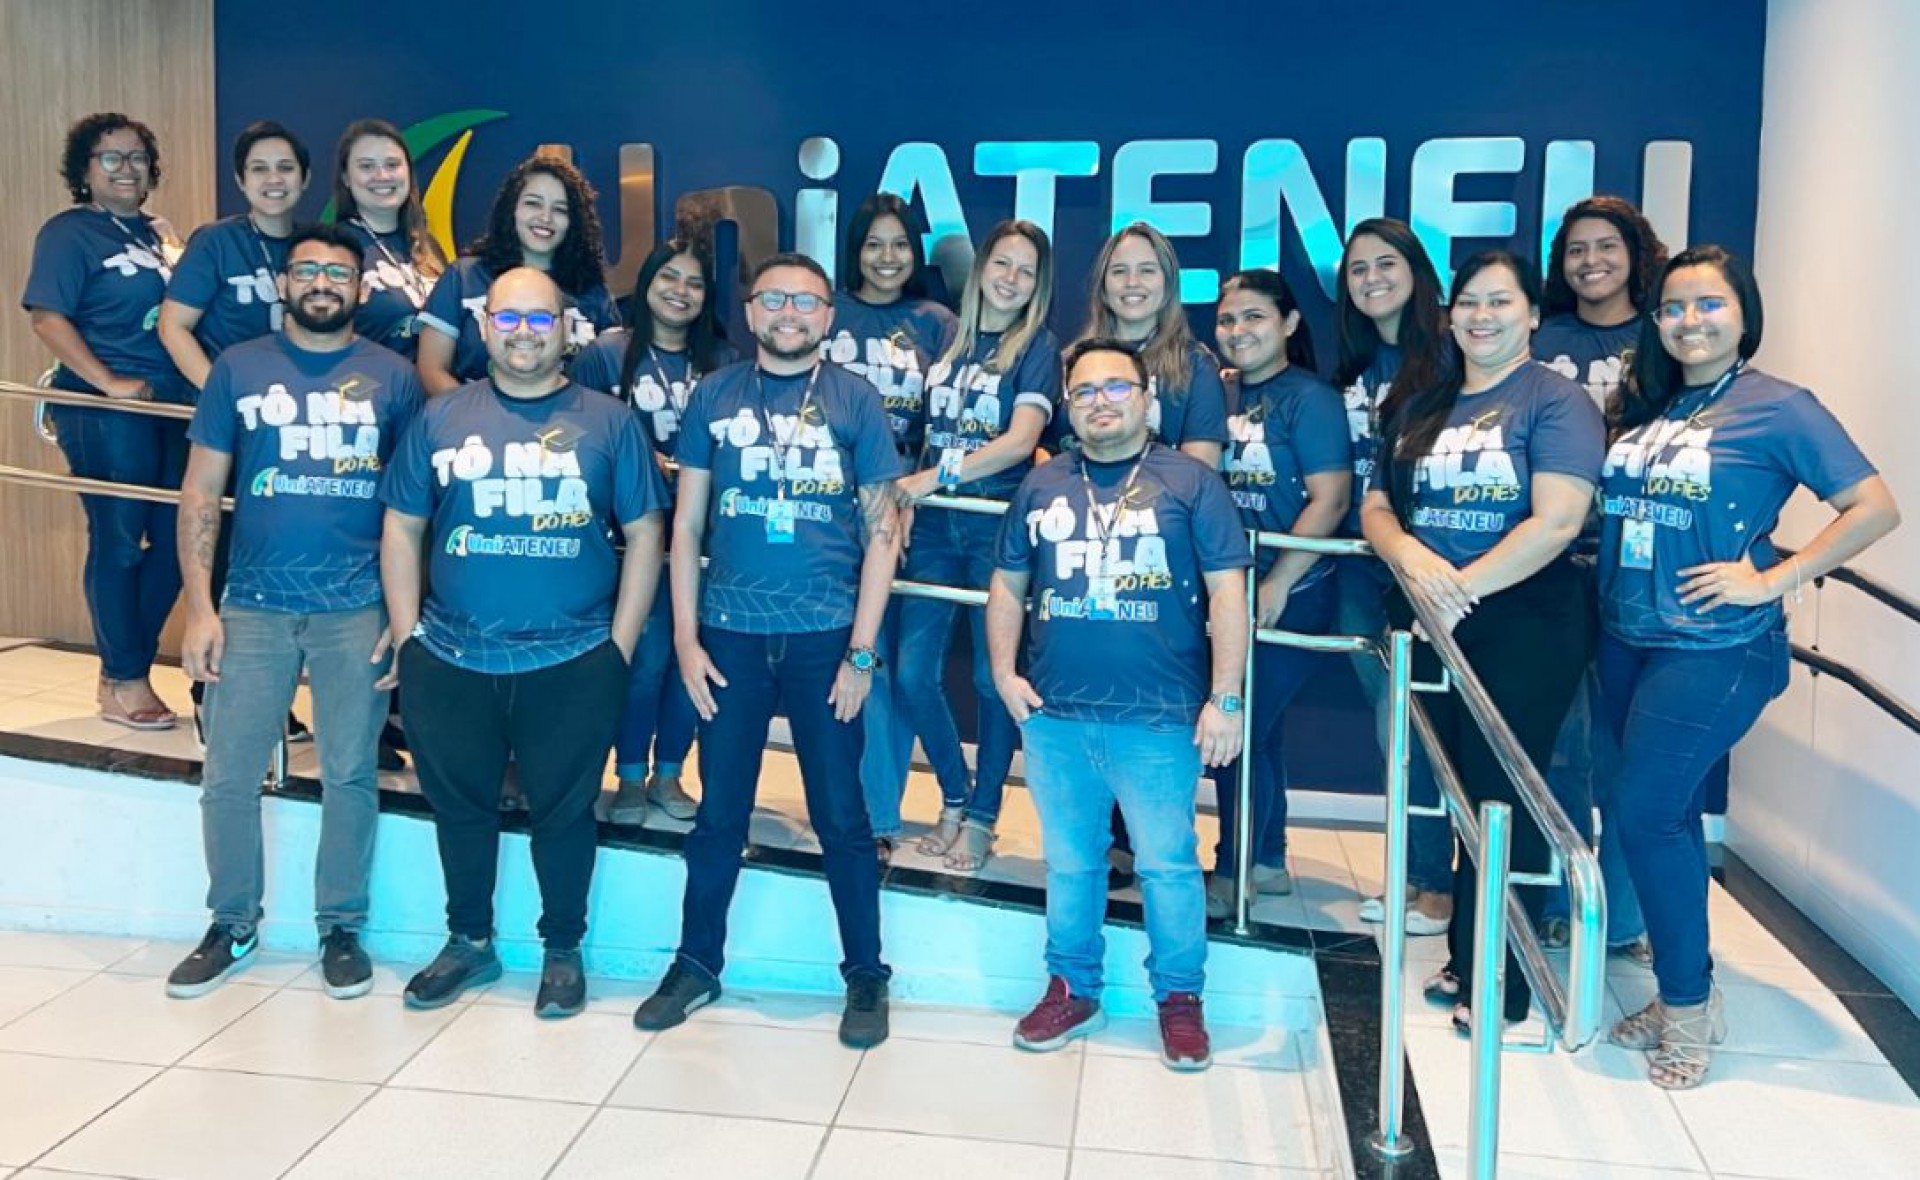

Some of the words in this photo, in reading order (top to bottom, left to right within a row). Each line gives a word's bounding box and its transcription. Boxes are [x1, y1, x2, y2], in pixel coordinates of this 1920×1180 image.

[537, 136, 1692, 304] UniATENEU
[842, 363, 923, 398] ILA
[236, 384, 298, 430] TÔ
[306, 391, 376, 425] NA
[280, 424, 379, 460] FILA
[709, 408, 761, 448] TÔ
[334, 457, 356, 474] DO
[432, 434, 493, 487] TÔ
[504, 442, 581, 478] NA
[740, 447, 844, 482] FILA
[273, 474, 376, 499] UniATENEU
[472, 477, 592, 517] FILA
[1454, 485, 1479, 504] DO
[1481, 484, 1521, 502] FIES
[1672, 479, 1712, 502] FIES
[532, 513, 560, 532] DO
[561, 510, 592, 528] FIES
[1026, 496, 1076, 547] TÔ
[1086, 502, 1159, 538] NA
[467, 533, 581, 559] UniATENEU
[1056, 536, 1170, 580] FILA
[1140, 572, 1172, 591] FIES
